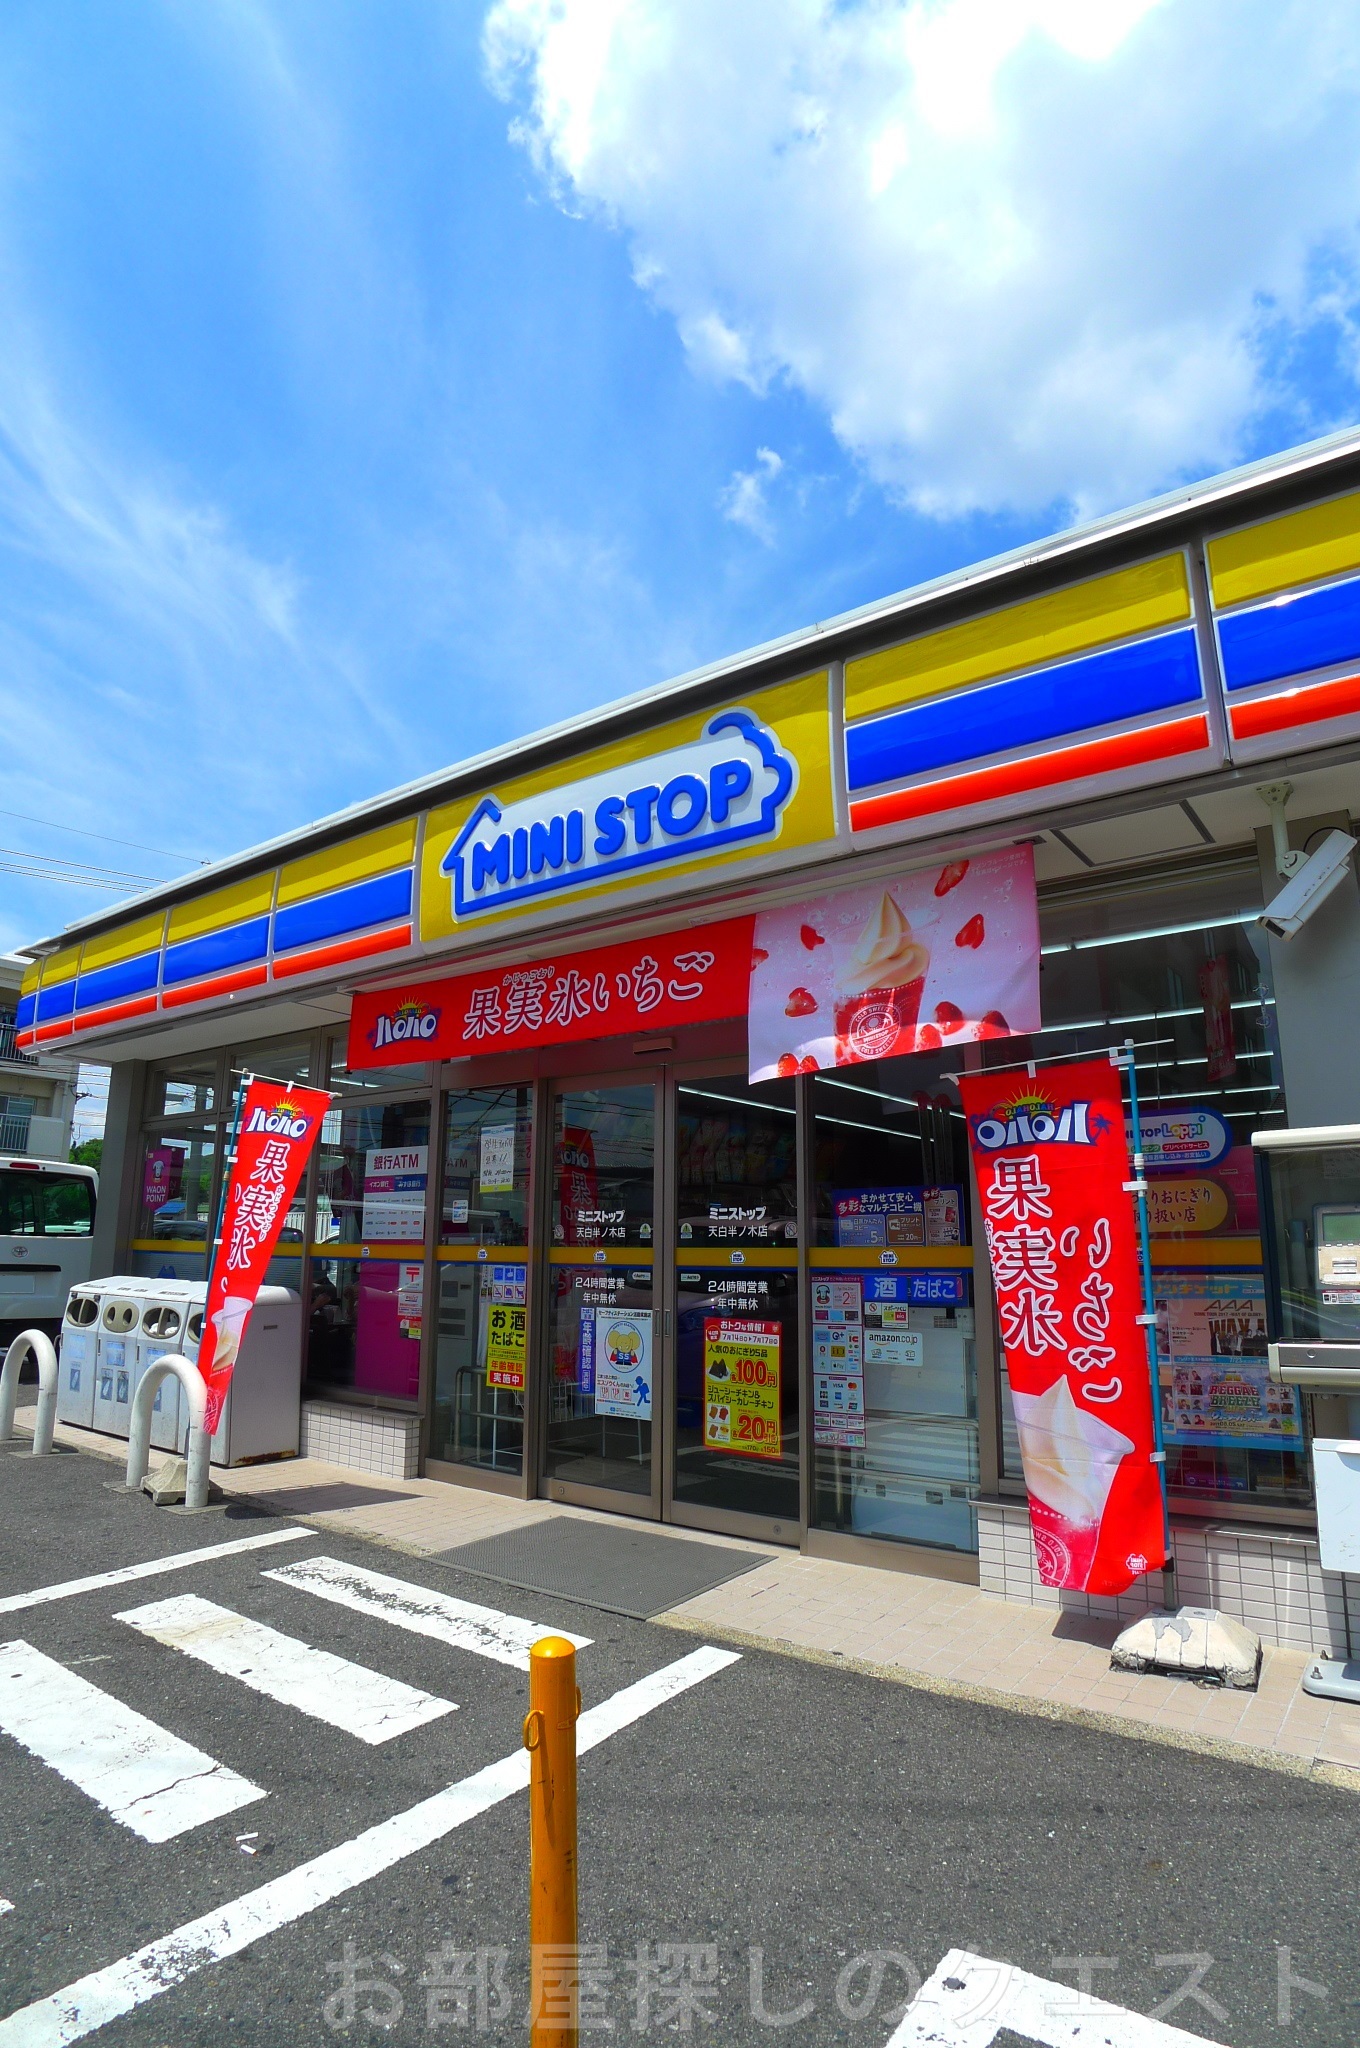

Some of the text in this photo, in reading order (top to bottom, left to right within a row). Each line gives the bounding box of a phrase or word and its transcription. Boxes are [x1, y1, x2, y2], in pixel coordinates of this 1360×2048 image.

[472, 759, 752, 892] MINI STOP
[462, 951, 715, 1040] 果実氷いちご
[1162, 1116, 1206, 1139] Loppi
[373, 1153, 419, 1171] 銀行ATM
[146, 1194, 166, 1202] POINT
[226, 1139, 292, 1271] 果実氷
[861, 1192, 914, 1204] まかせて安心
[709, 1206, 767, 1221] ミニストップ
[838, 1199, 922, 1215] 多彩なマルチコピー機
[577, 1210, 626, 1223] ミニストップ
[576, 1226, 626, 1239] 天白半ノ木店
[708, 1224, 768, 1238] 天白半ノ木店
[575, 1277, 626, 1290] 24時間営業
[708, 1280, 769, 1294] 24時間営業
[874, 1277, 955, 1298] 酒 たばこ
[582, 1292, 617, 1305] 年中無休
[716, 1297, 759, 1310] 年中無休
[1204, 1299, 1253, 1312] AAA
[491, 1309, 526, 1332] お酒
[720, 1321, 765, 1333] おトクな情報!
[491, 1331, 525, 1348] たばこ
[869, 1332, 918, 1346] amazon.co.jp
[707, 1344, 768, 1358] 人気のおにぎり5品
[491, 1360, 523, 1373] 年齢確認
[493, 1372, 520, 1385] 実施中
[1209, 1385, 1259, 1396] REGGAE
[707, 1394, 774, 1409] スパイシーカレーチキン
[1210, 1396, 1261, 1407] BREEZE
